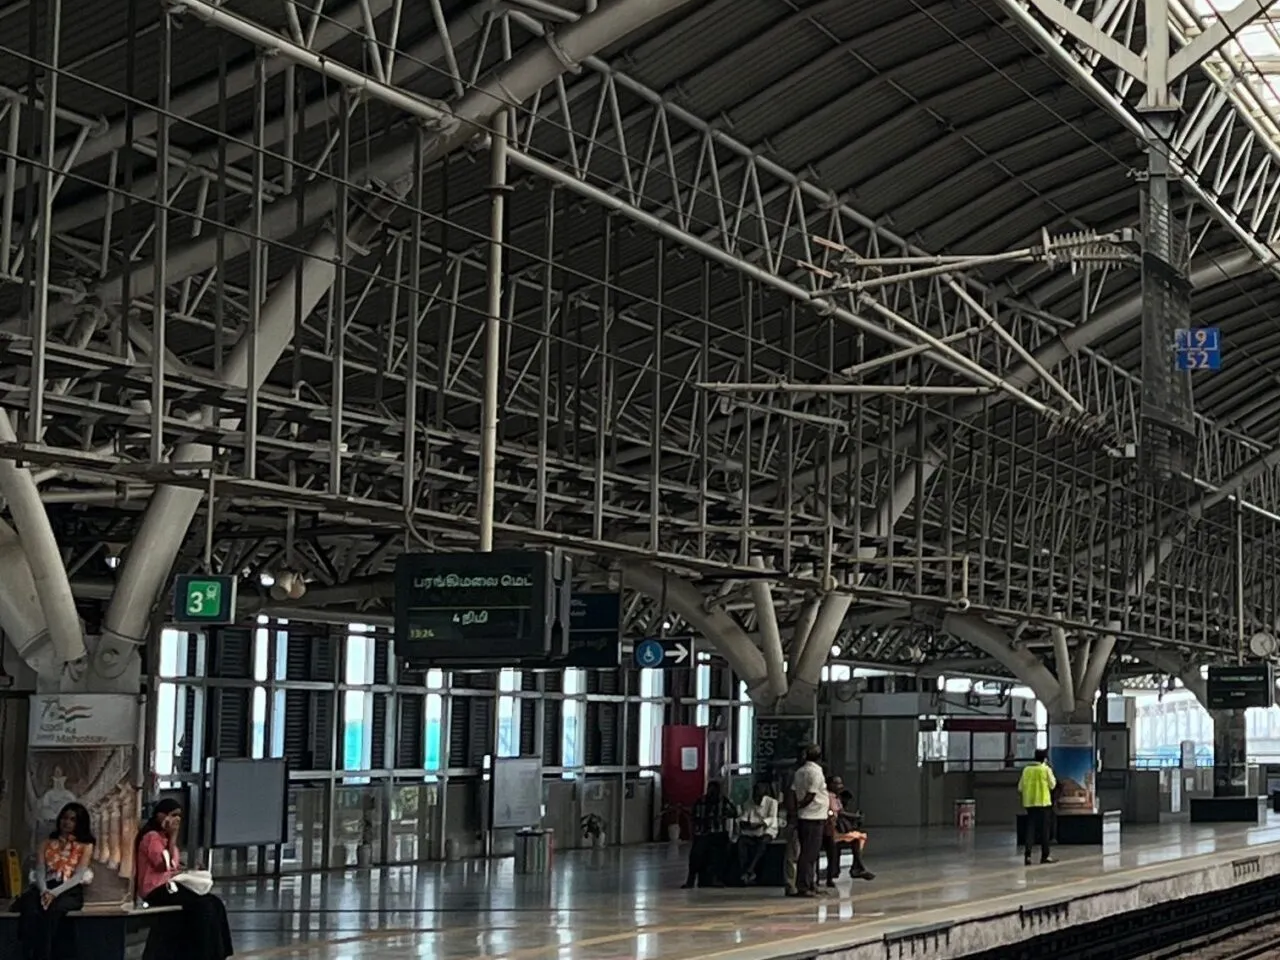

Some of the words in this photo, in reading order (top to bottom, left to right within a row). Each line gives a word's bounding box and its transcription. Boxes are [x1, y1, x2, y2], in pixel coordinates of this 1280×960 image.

[1186, 350, 1210, 369] 52
[190, 591, 204, 614] 3
[410, 629, 435, 639] 13:24
